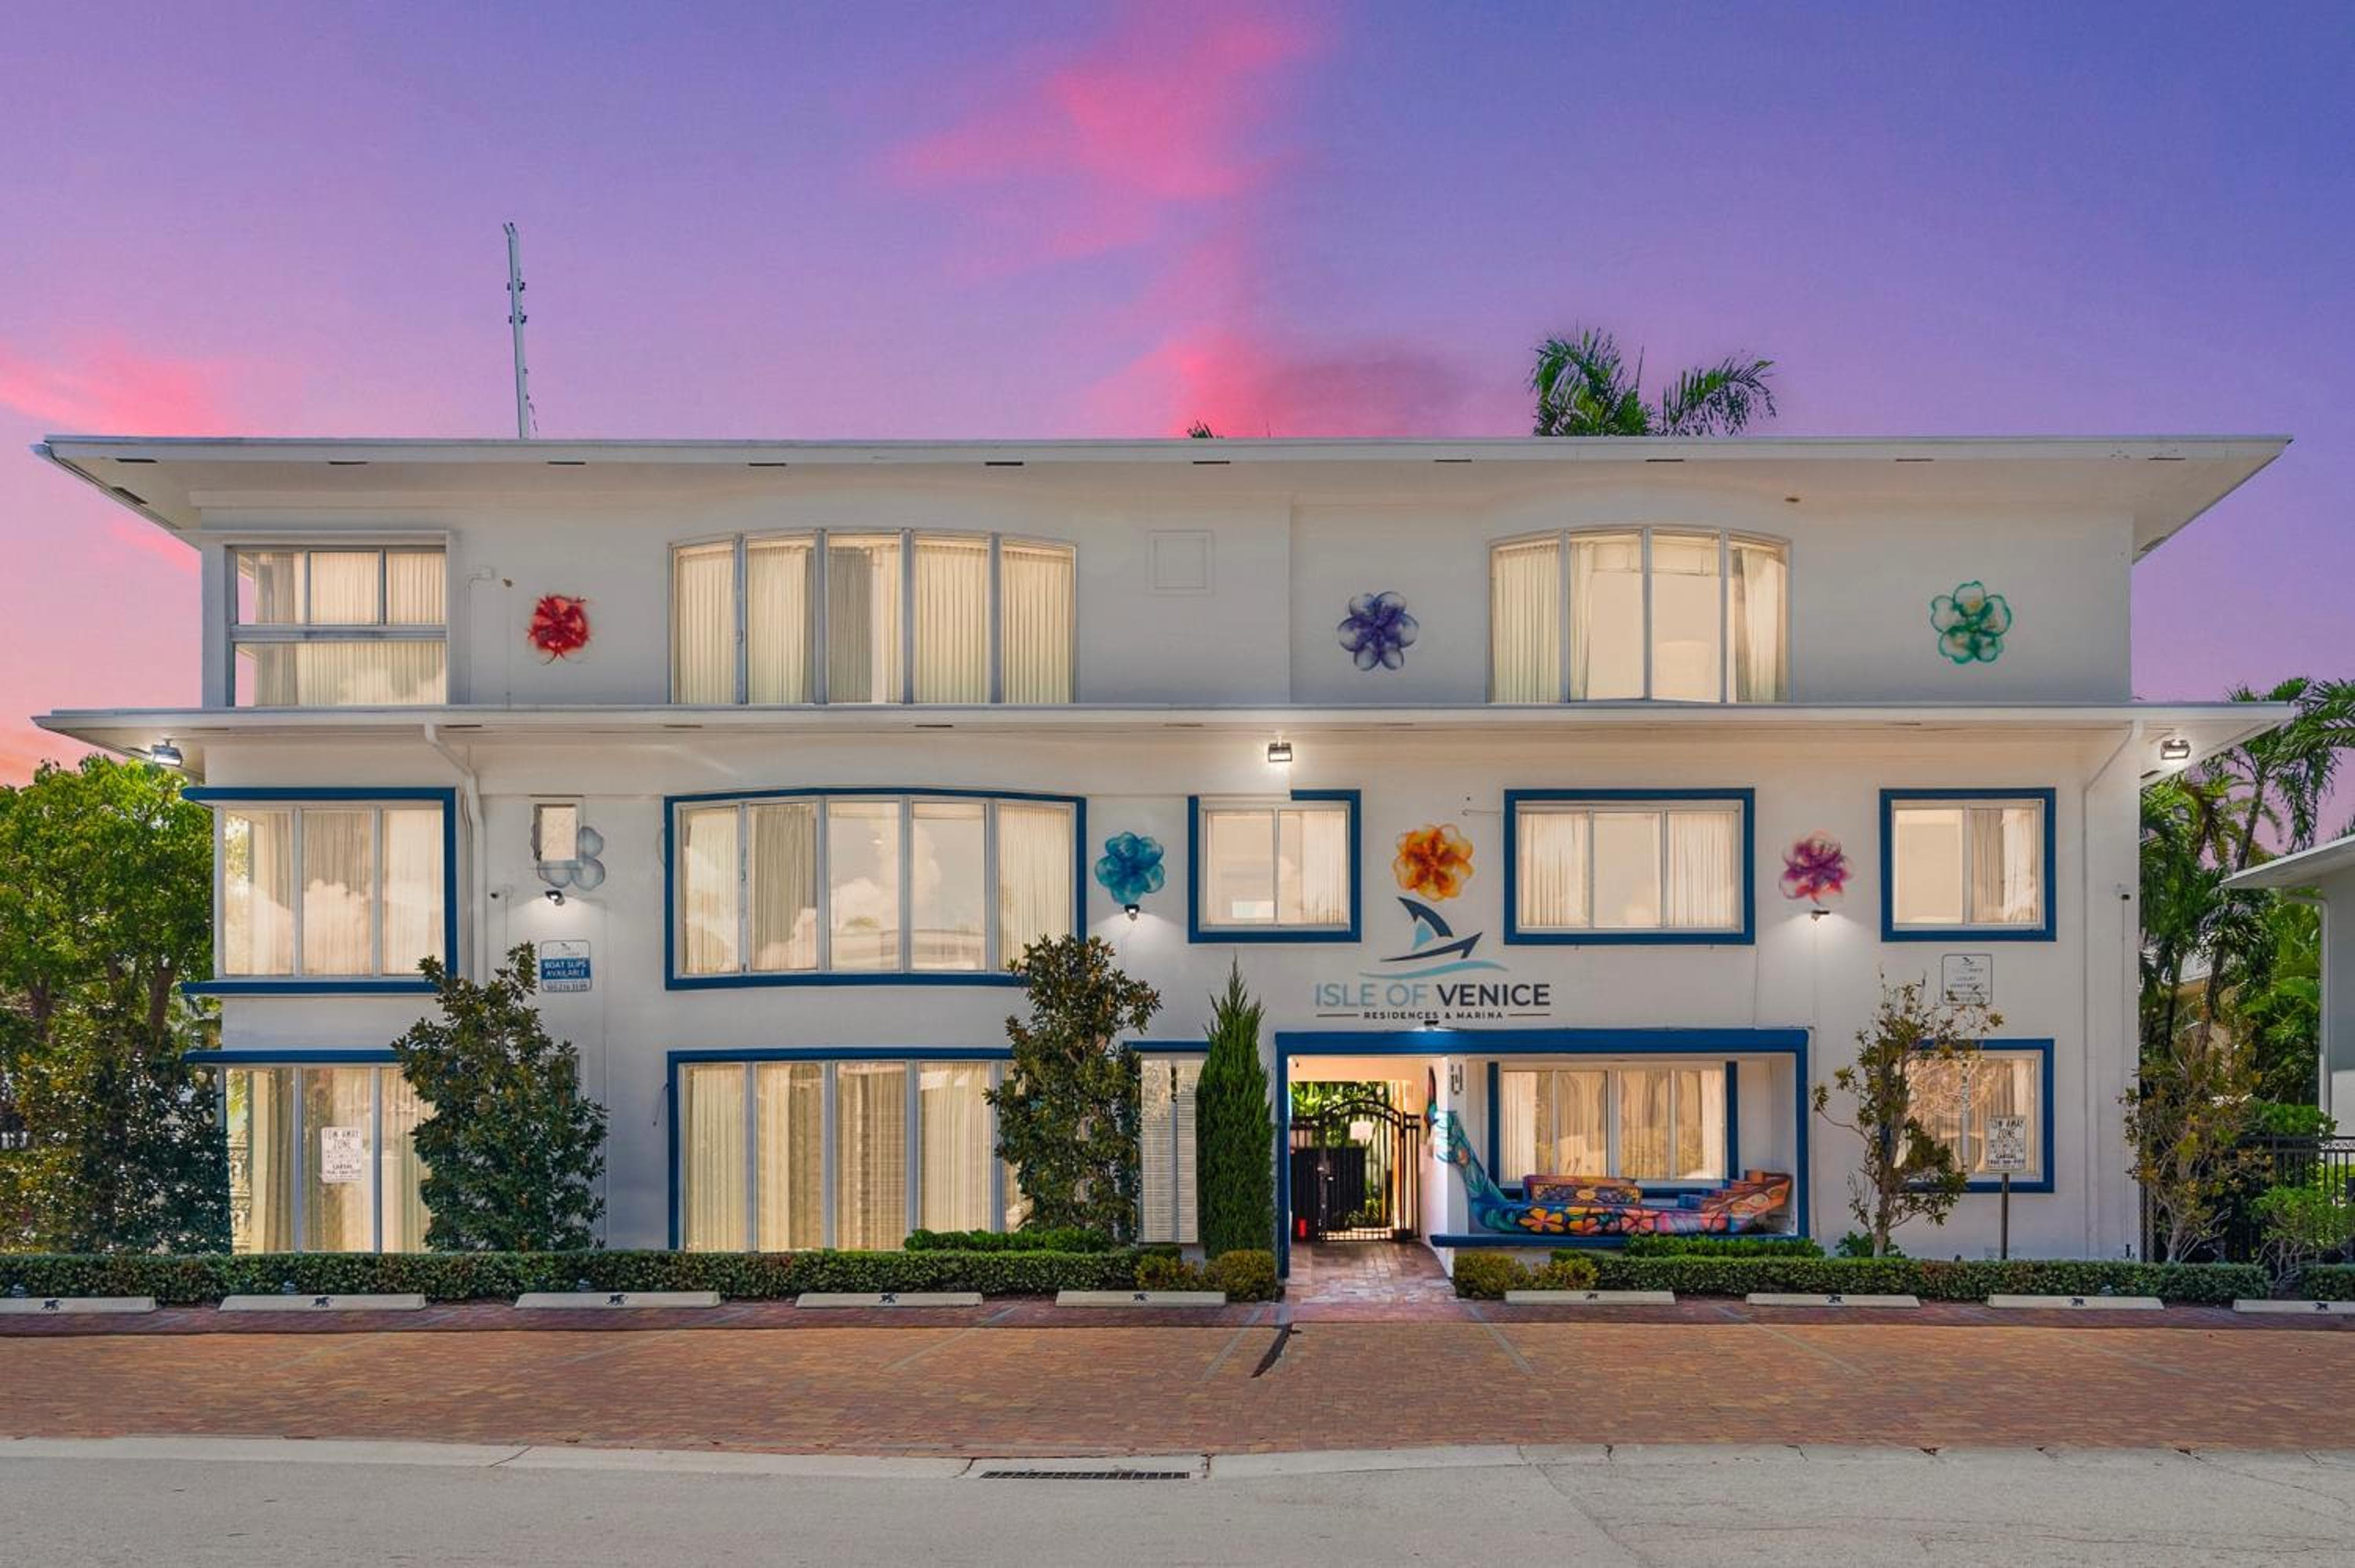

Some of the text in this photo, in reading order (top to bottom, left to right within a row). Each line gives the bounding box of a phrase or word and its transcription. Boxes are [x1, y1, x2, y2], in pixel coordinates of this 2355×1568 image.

[1314, 983, 1550, 1007] ISLE OF VENICE
[1364, 1011, 1440, 1019] RESIDENCES
[1456, 1011, 1503, 1019] MARINA
